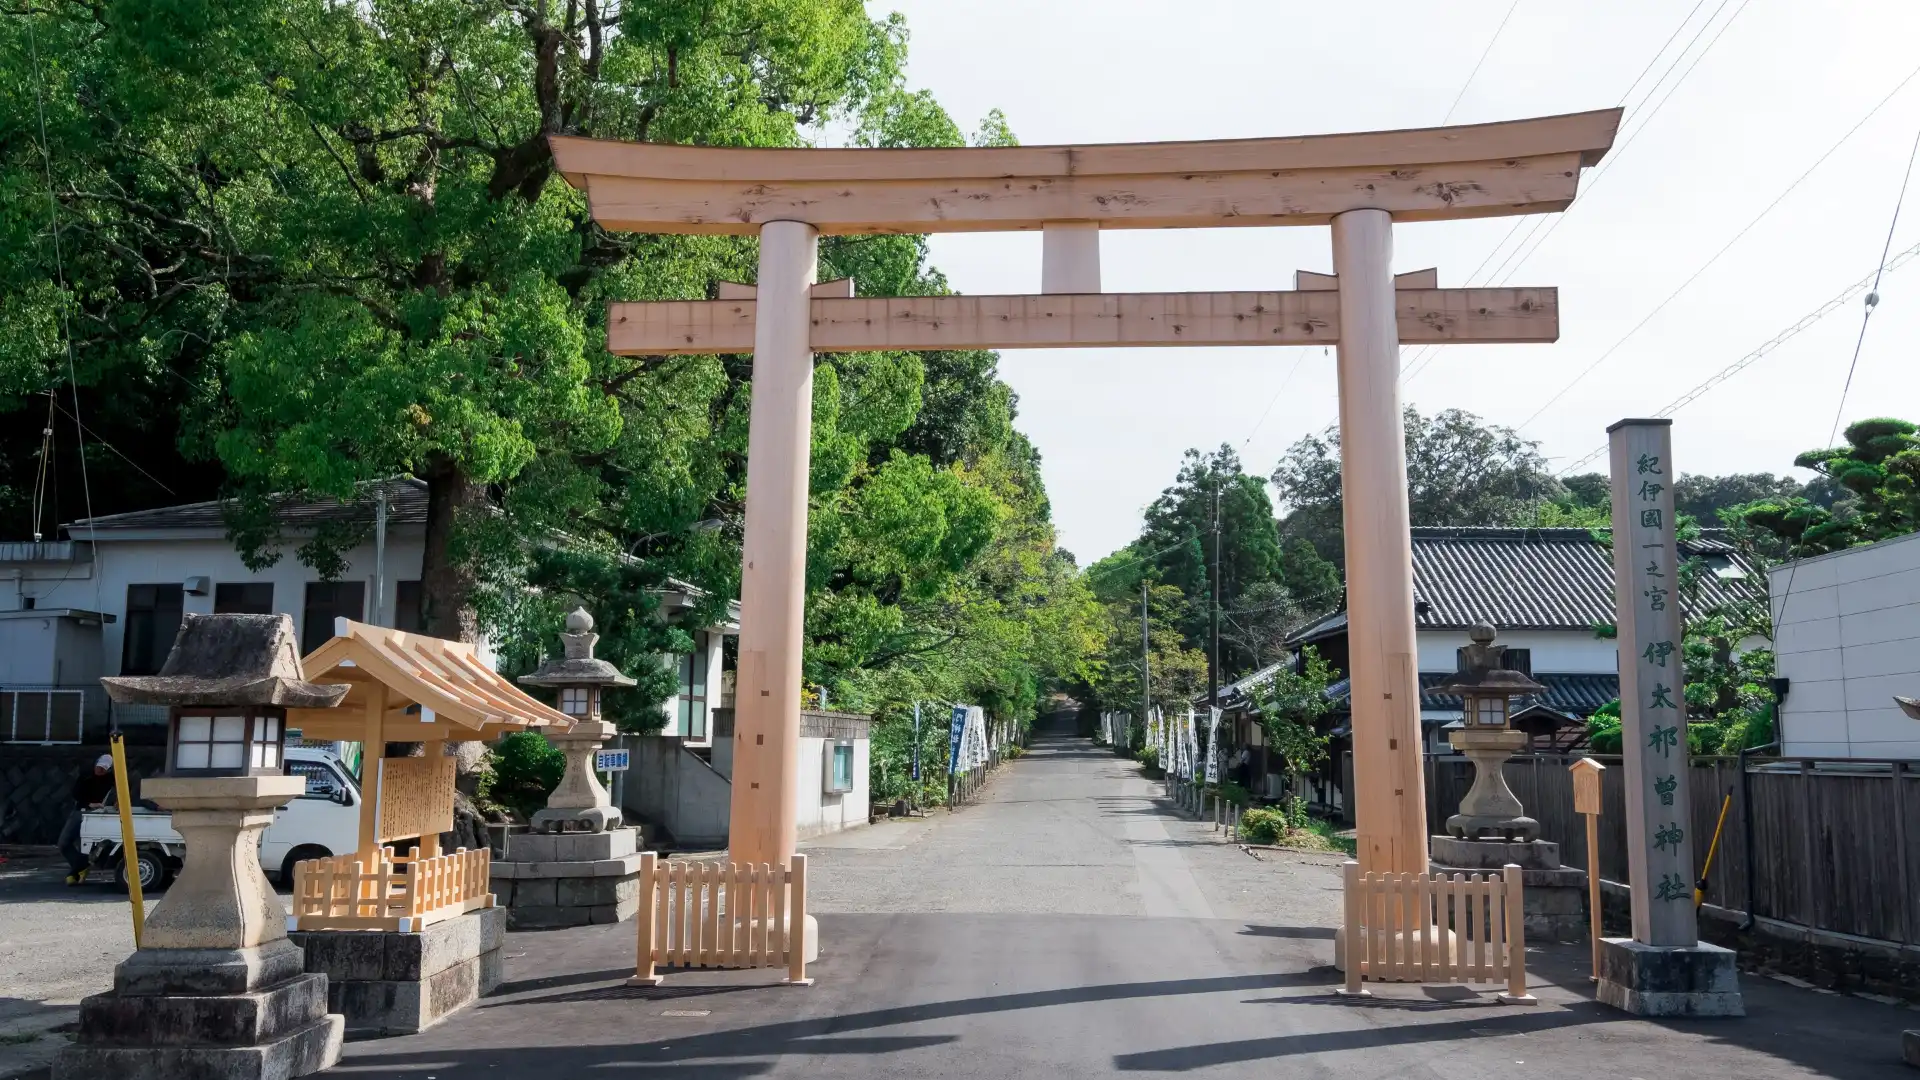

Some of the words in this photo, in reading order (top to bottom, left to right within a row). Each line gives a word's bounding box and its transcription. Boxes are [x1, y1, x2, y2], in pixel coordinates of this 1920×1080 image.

[1637, 453, 1668, 611] 紀伊國一之宮
